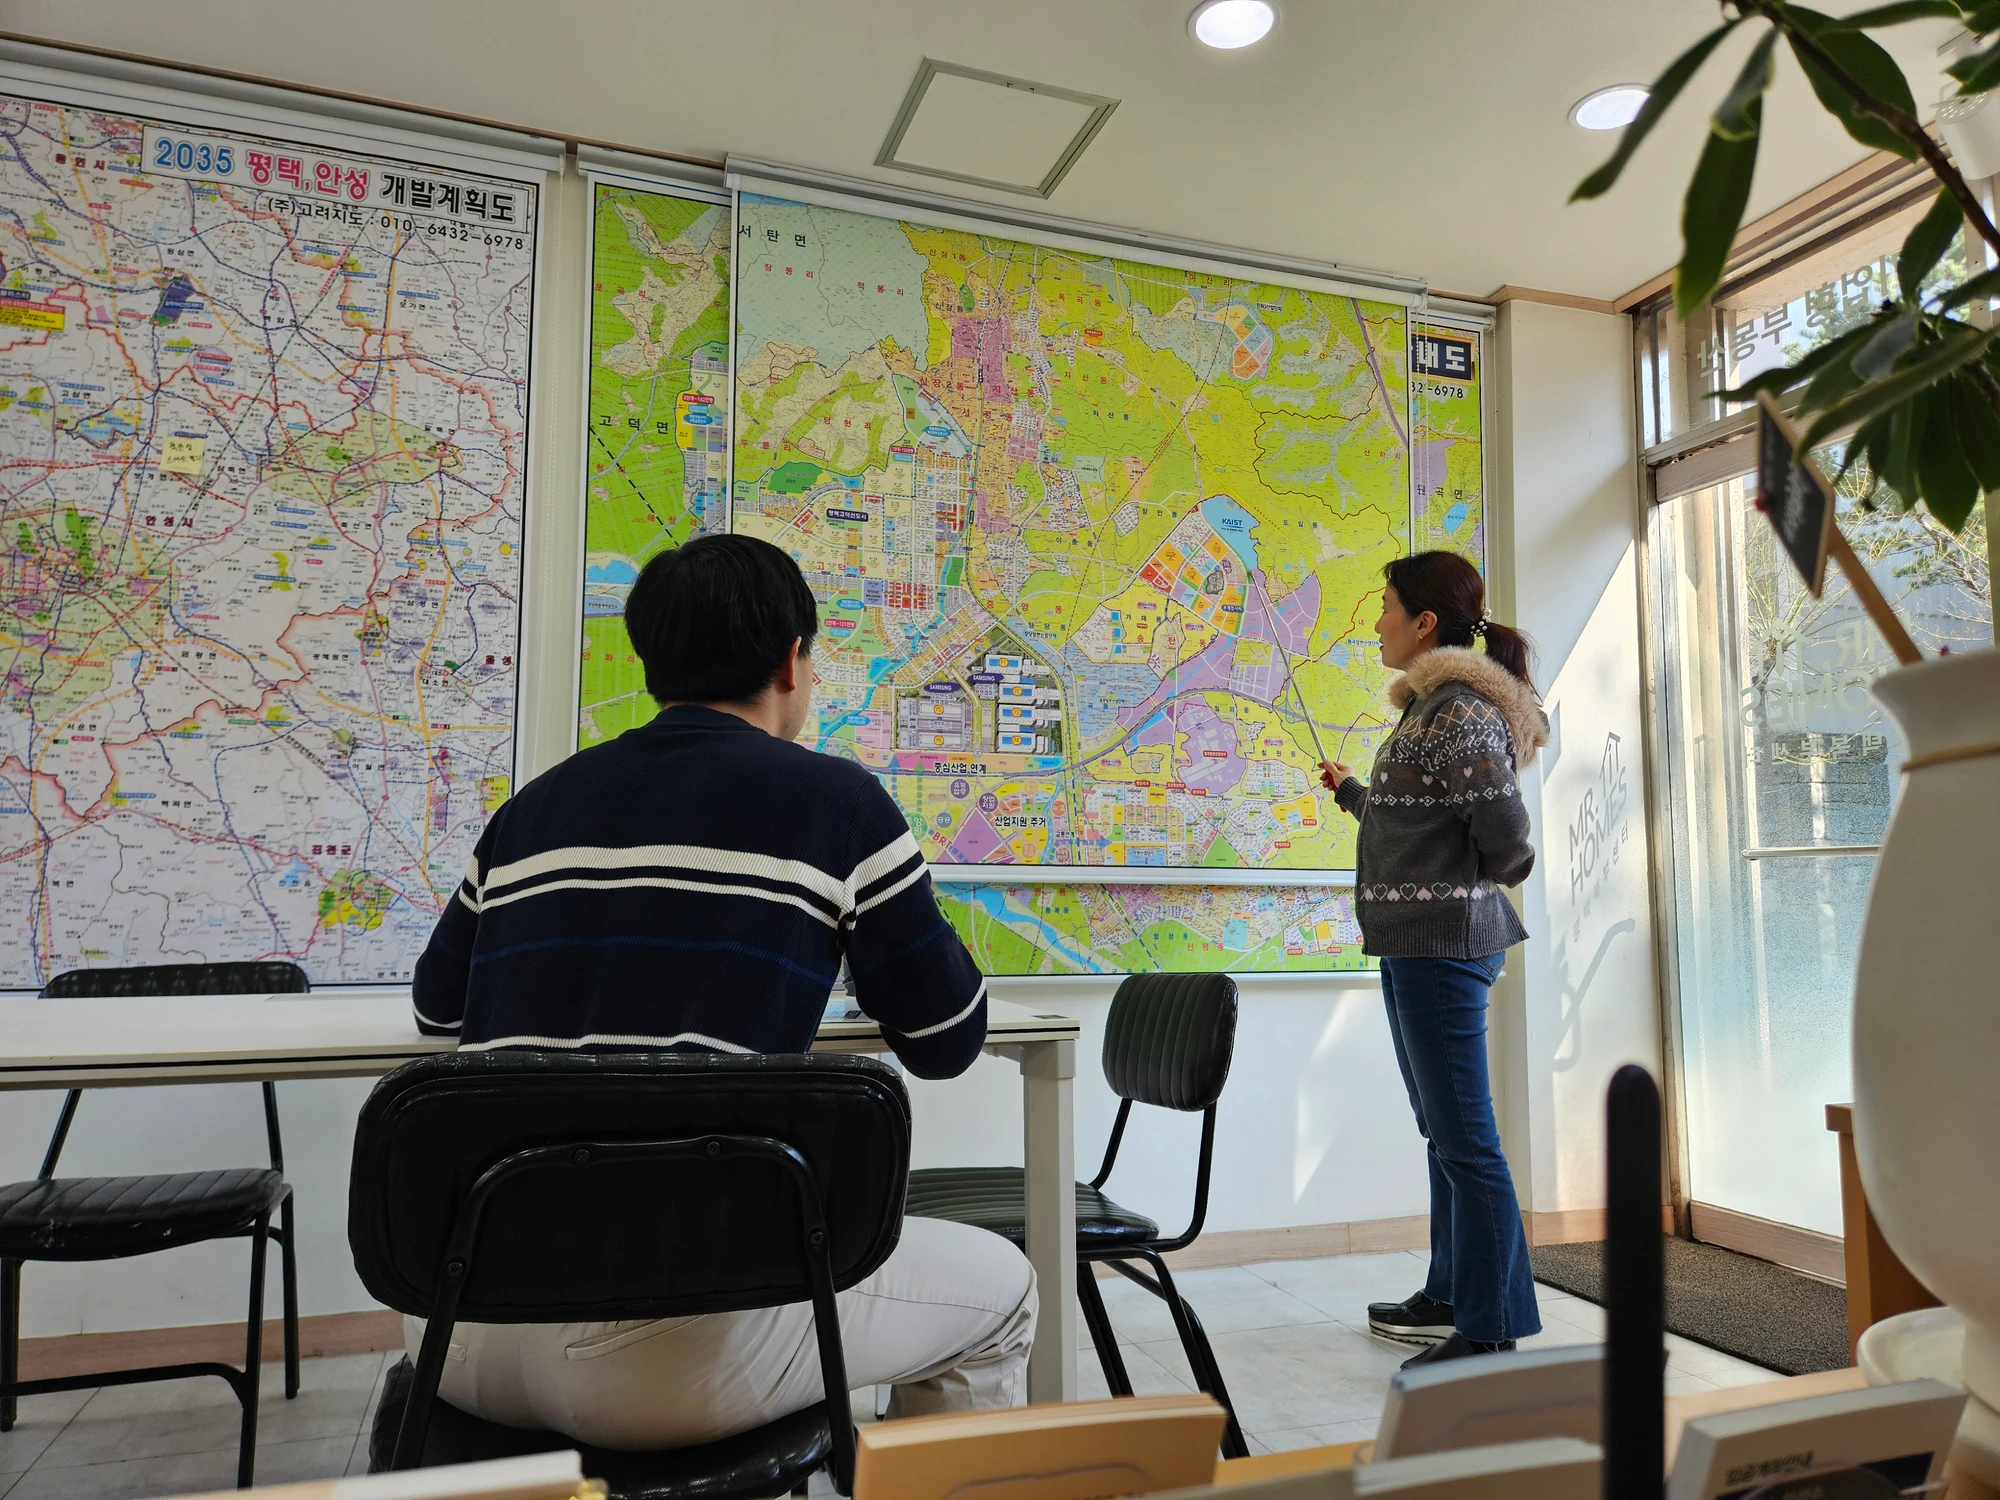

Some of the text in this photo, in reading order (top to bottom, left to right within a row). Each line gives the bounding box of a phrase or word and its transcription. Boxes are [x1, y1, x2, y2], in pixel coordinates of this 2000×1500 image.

[155, 137, 515, 223] 2035 평택,안성 개발계획도
[268, 197, 364, 227] (주)고려지도
[380, 215, 525, 251] 010-6432-6978
[739, 225, 807, 248] 서탄면
[929, 248, 966, 262] 신장1동
[857, 281, 904, 297] 적봉리
[1411, 339, 1466, 372] 내도
[599, 415, 668, 435] 고덕면
[1222, 518, 1243, 526] KAIST
[973, 674, 995, 682] SAMSUNG
[934, 763, 987, 774] 중심산업 연계
[937, 816, 951, 824] 공공
[995, 816, 1046, 827] 산업지원 주거
[933, 831, 952, 849] BRT
[1571, 766, 1627, 907] HOMES
